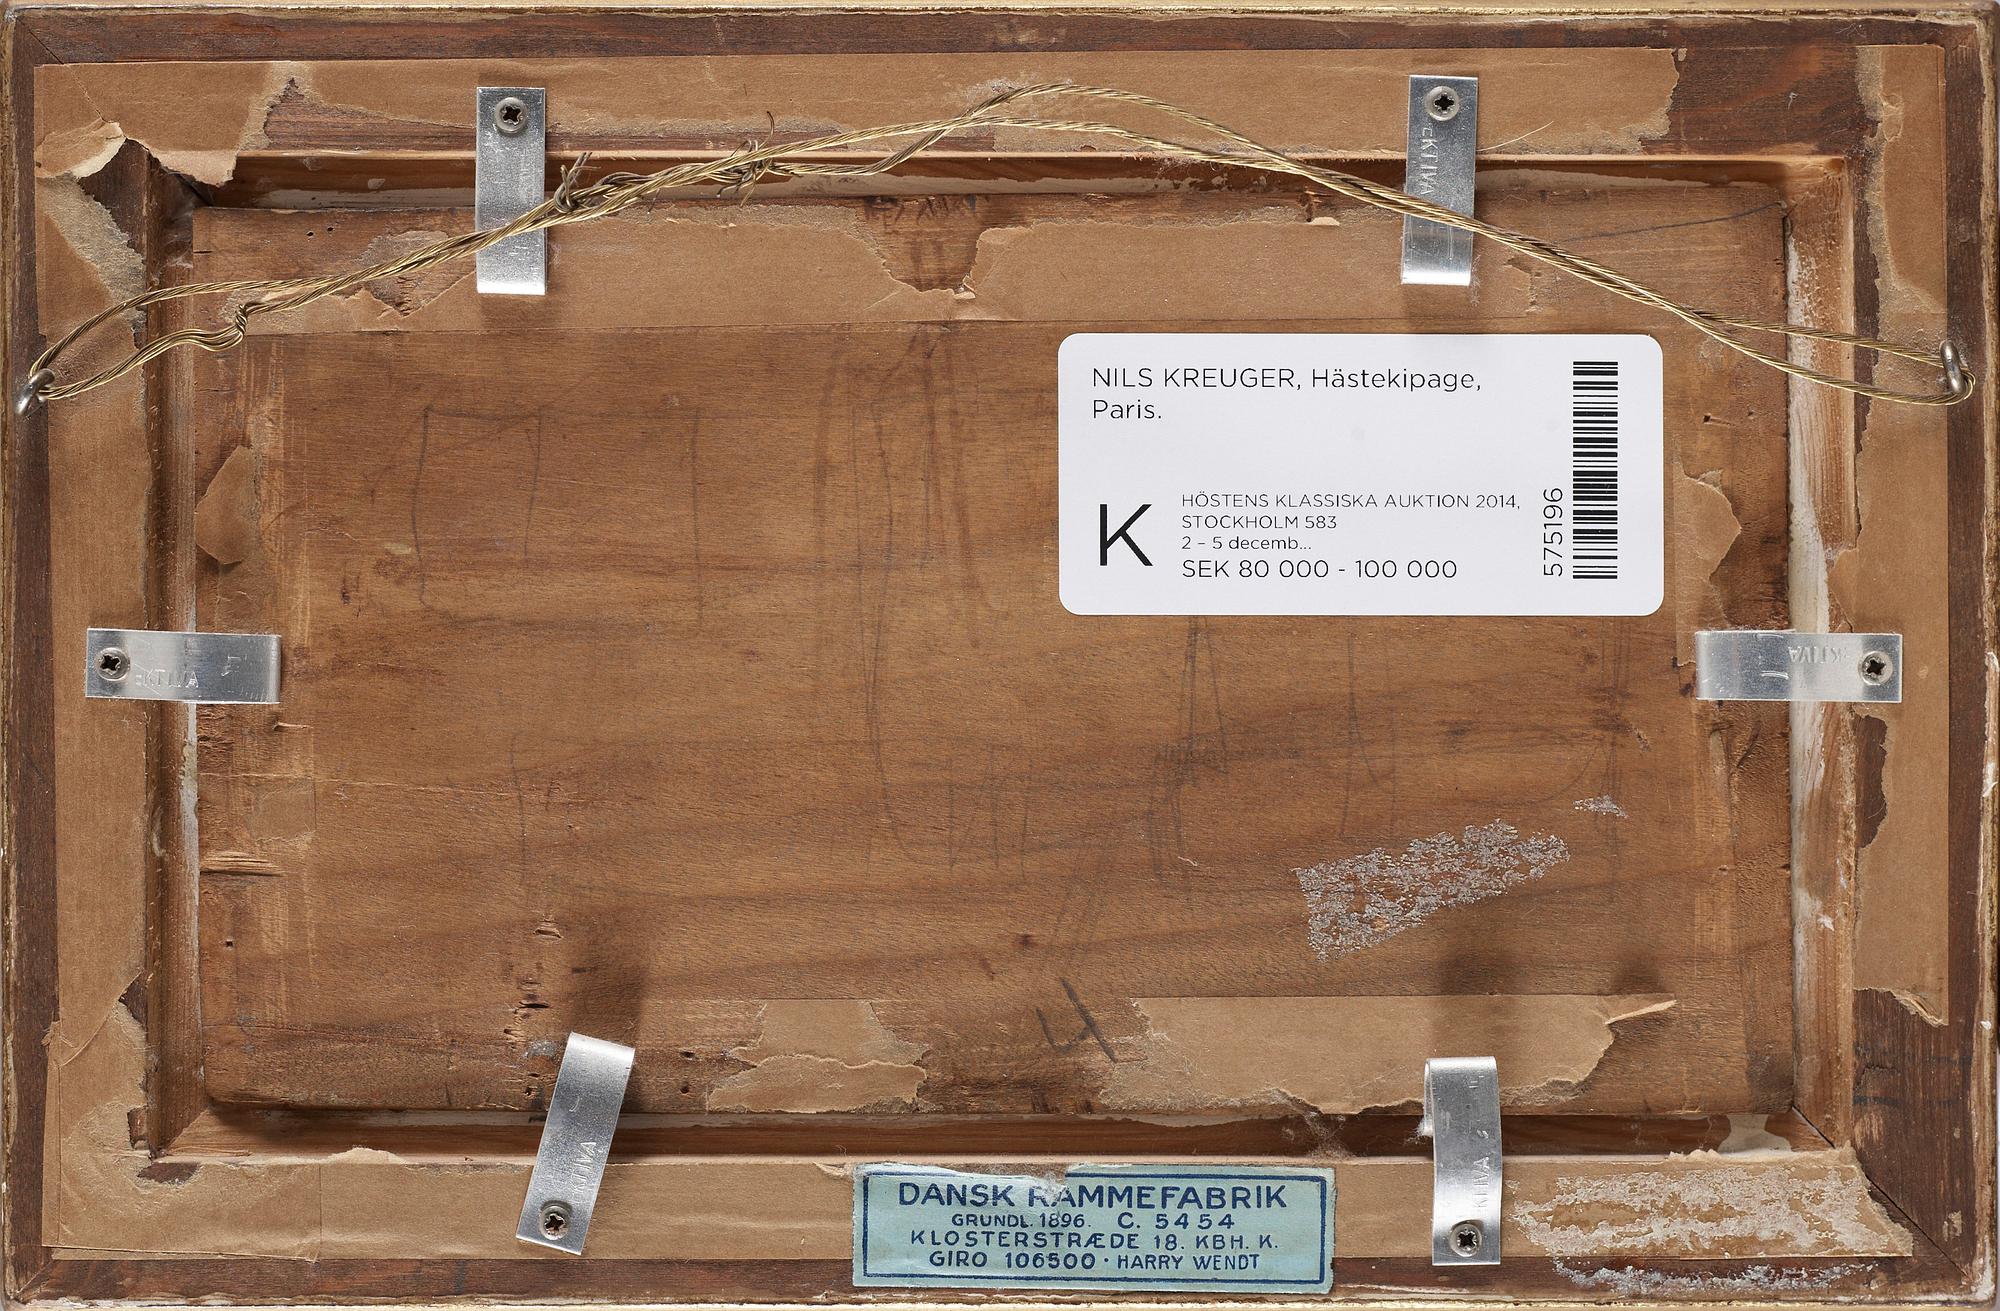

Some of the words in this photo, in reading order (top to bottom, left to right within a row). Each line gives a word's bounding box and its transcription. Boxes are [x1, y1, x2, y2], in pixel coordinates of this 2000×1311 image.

[1093, 367, 1153, 388] NILS
[1164, 367, 1301, 391] KREUGER,
[1312, 367, 1481, 393] Hästekipage,
[1093, 398, 1162, 420] Paris.
[1182, 491, 1269, 508] HÖSTENS
[1275, 493, 1378, 508] KLASSISKA
[1384, 493, 1469, 508] AUKTION
[1475, 494, 1520, 511] 2014,
[1182, 514, 1299, 529] STOCKHOLM
[1304, 515, 1337, 529] 583
[1542, 487, 1564, 577] 575196
[1099, 503, 1154, 567] K
[1181, 535, 1192, 550] 2
[1212, 536, 1223, 550] 5
[1228, 535, 1312, 550] decemb...
[1182, 559, 1230, 578] SEK
[1238, 559, 1270, 578] 80
[1279, 559, 1329, 578] 000
[1355, 559, 1397, 578] 100
[1407, 559, 1457, 578] 000
[899, 1182, 1016, 1208] DANSK
[1028, 1184, 1288, 1210] RAMMEFABRIK
[951, 1213, 1033, 1229] GRUNDL.
[1039, 1212, 1092, 1229] 1896.
[1117, 1211, 1141, 1230] C.
[911, 1230, 1140, 1250] KLOSTERSTRÆDE
[1153, 1234, 1185, 1251] 18.
[1195, 1235, 1249, 1251] KBH.
[1259, 1235, 1279, 1250] K.
[929, 1250, 988, 1268] GIRO
[1004, 1252, 1096, 1270] 106500
[1117, 1254, 1184, 1270] HARRY
[1193, 1254, 1260, 1271] WENDT
